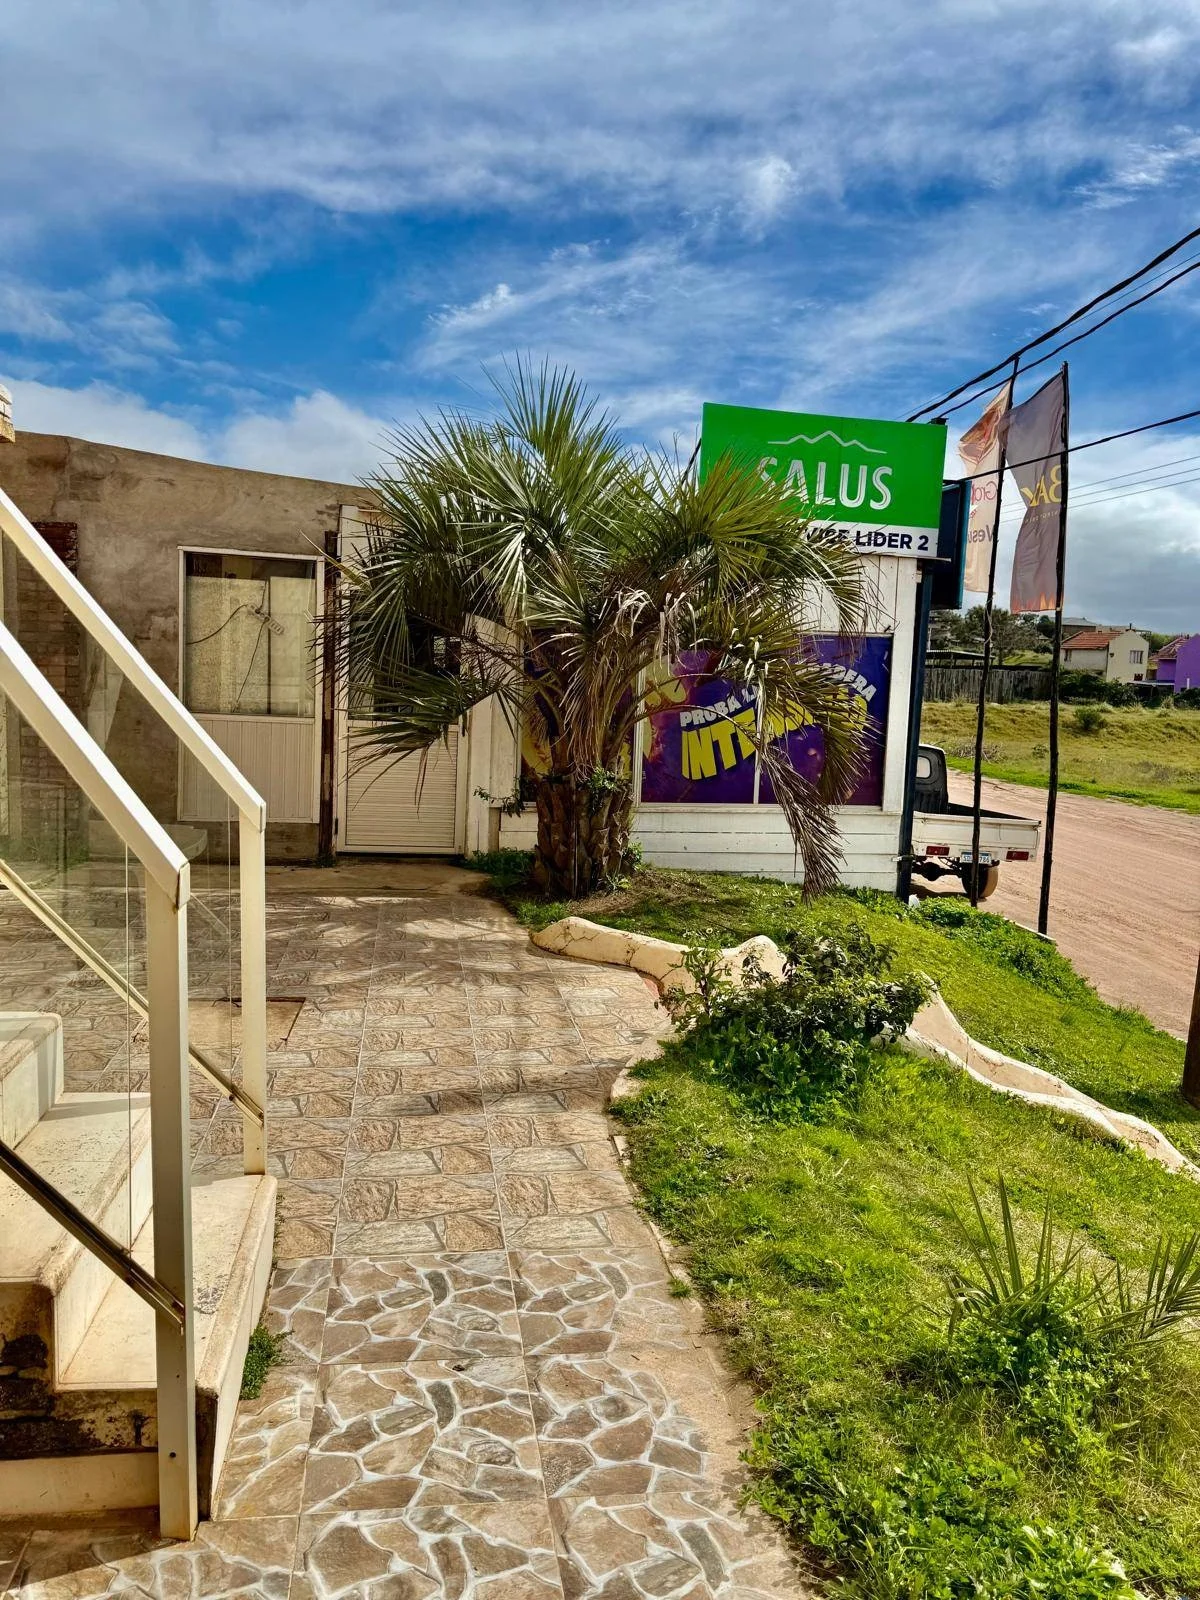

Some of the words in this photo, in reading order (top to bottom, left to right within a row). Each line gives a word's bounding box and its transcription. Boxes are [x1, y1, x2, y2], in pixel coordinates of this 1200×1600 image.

[757, 456, 893, 510] SALUS
[855, 530, 913, 549] LIDER
[917, 535, 929, 551] 2
